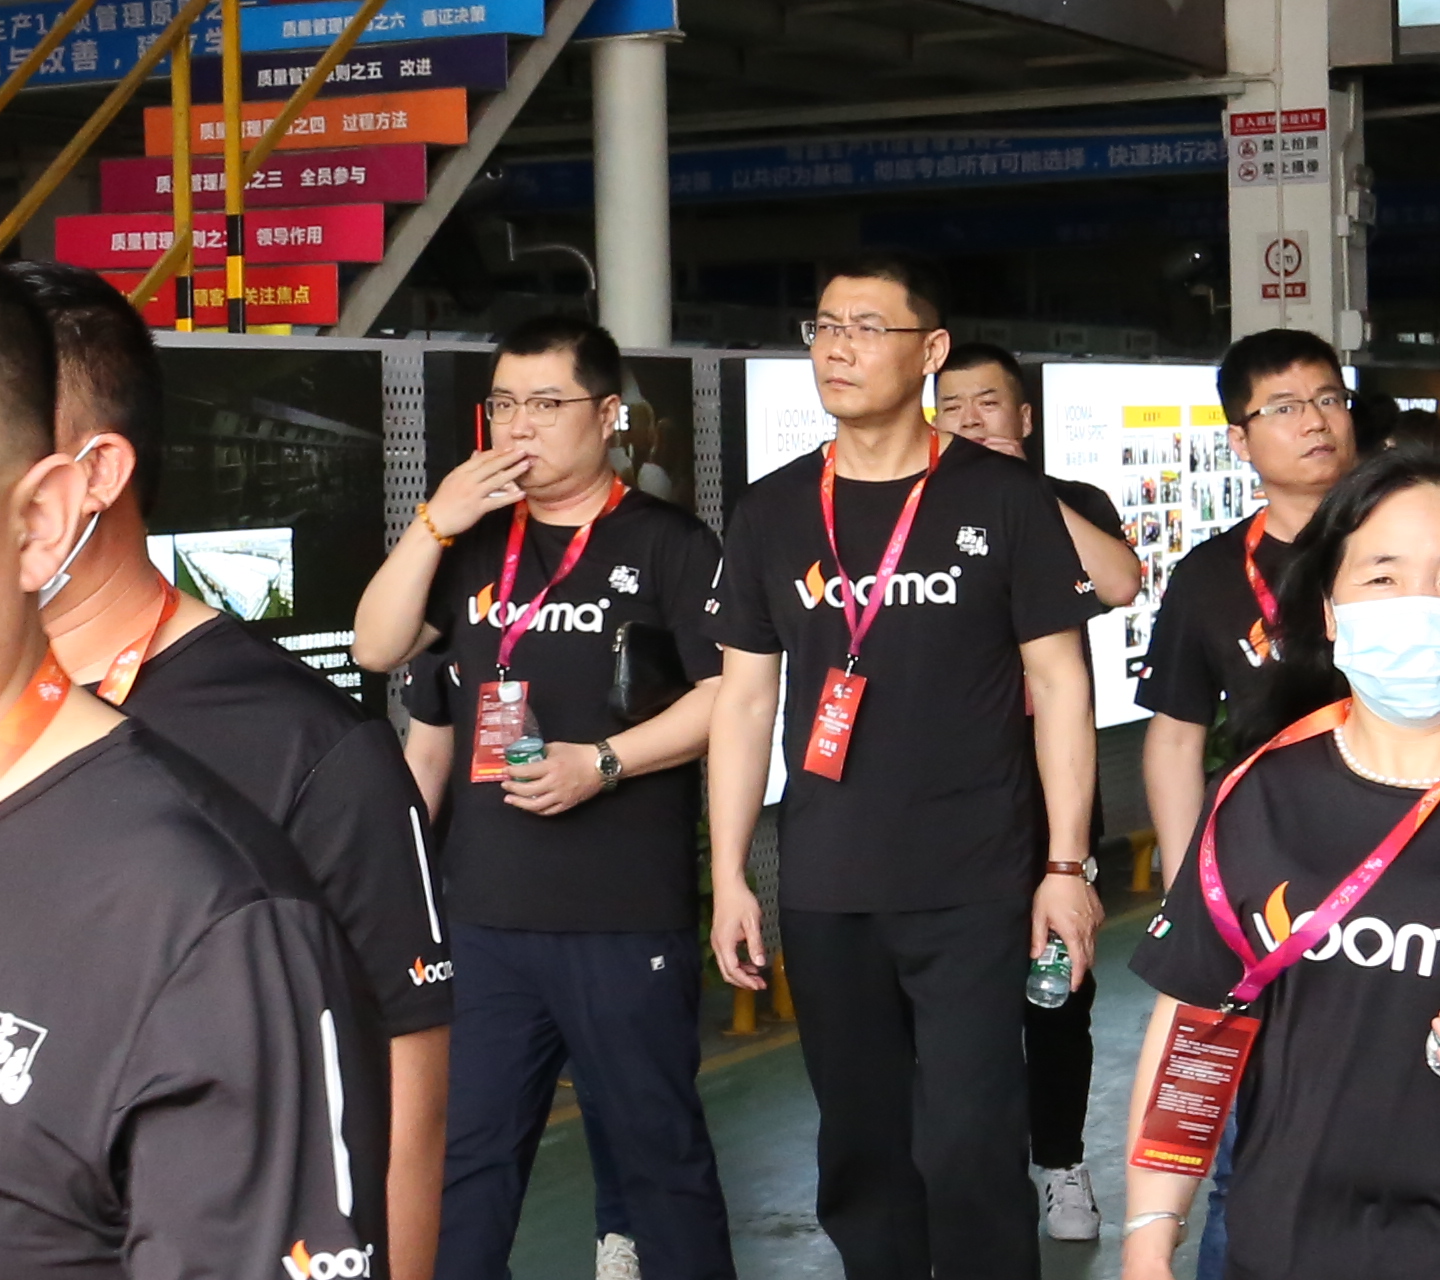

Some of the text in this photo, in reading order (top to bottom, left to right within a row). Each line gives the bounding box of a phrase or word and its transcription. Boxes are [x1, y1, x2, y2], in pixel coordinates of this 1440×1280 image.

[399, 57, 432, 78] 改进
[343, 111, 408, 132] 过程方法
[300, 167, 366, 187] 全员参与
[256, 226, 322, 248] 领导作用
